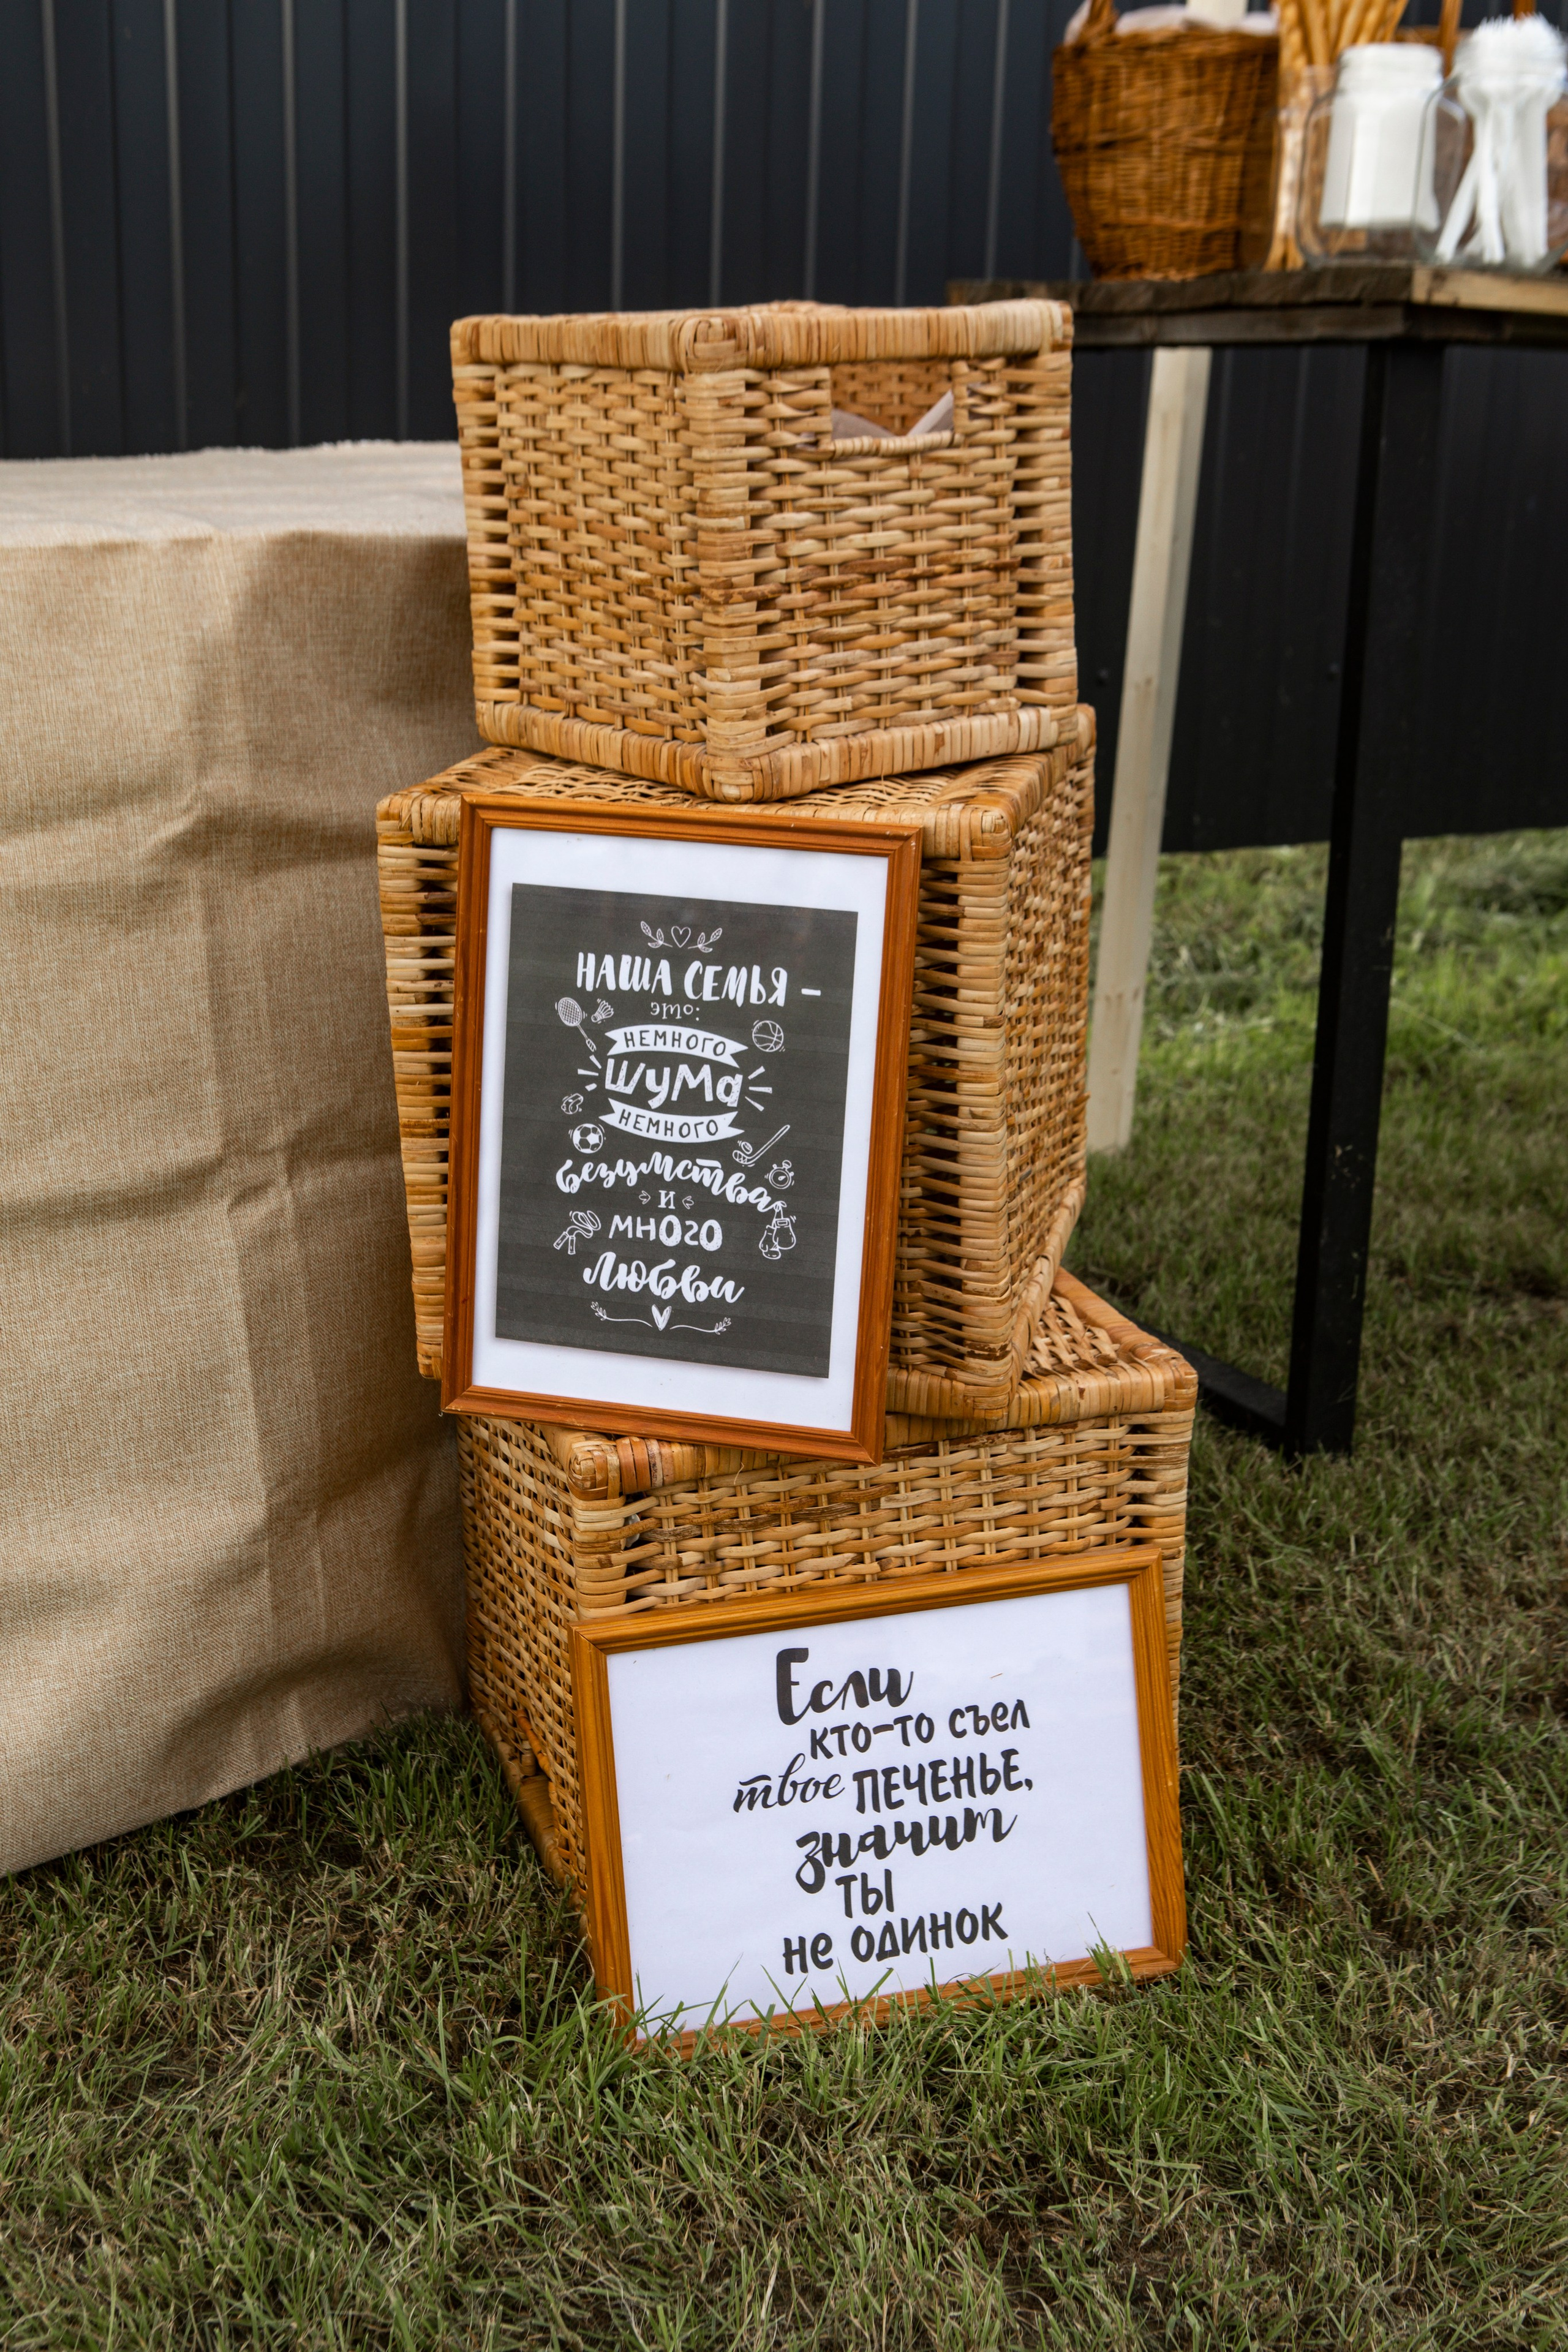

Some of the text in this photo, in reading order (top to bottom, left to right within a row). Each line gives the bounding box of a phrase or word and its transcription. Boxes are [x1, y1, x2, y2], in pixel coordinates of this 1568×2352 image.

[576, 952, 672, 995] НАША
[684, 960, 788, 1007] СЕМЬЯ
[650, 1002, 700, 1021] это:
[624, 1029, 727, 1057] НЕМНОГО
[618, 1107, 719, 1138] НЕМНОГО
[775, 1647, 914, 1725] Если
[733, 1748, 1033, 1814] твое ПЕЧЕНЬЕ,
[795, 1807, 1018, 1894] значит
